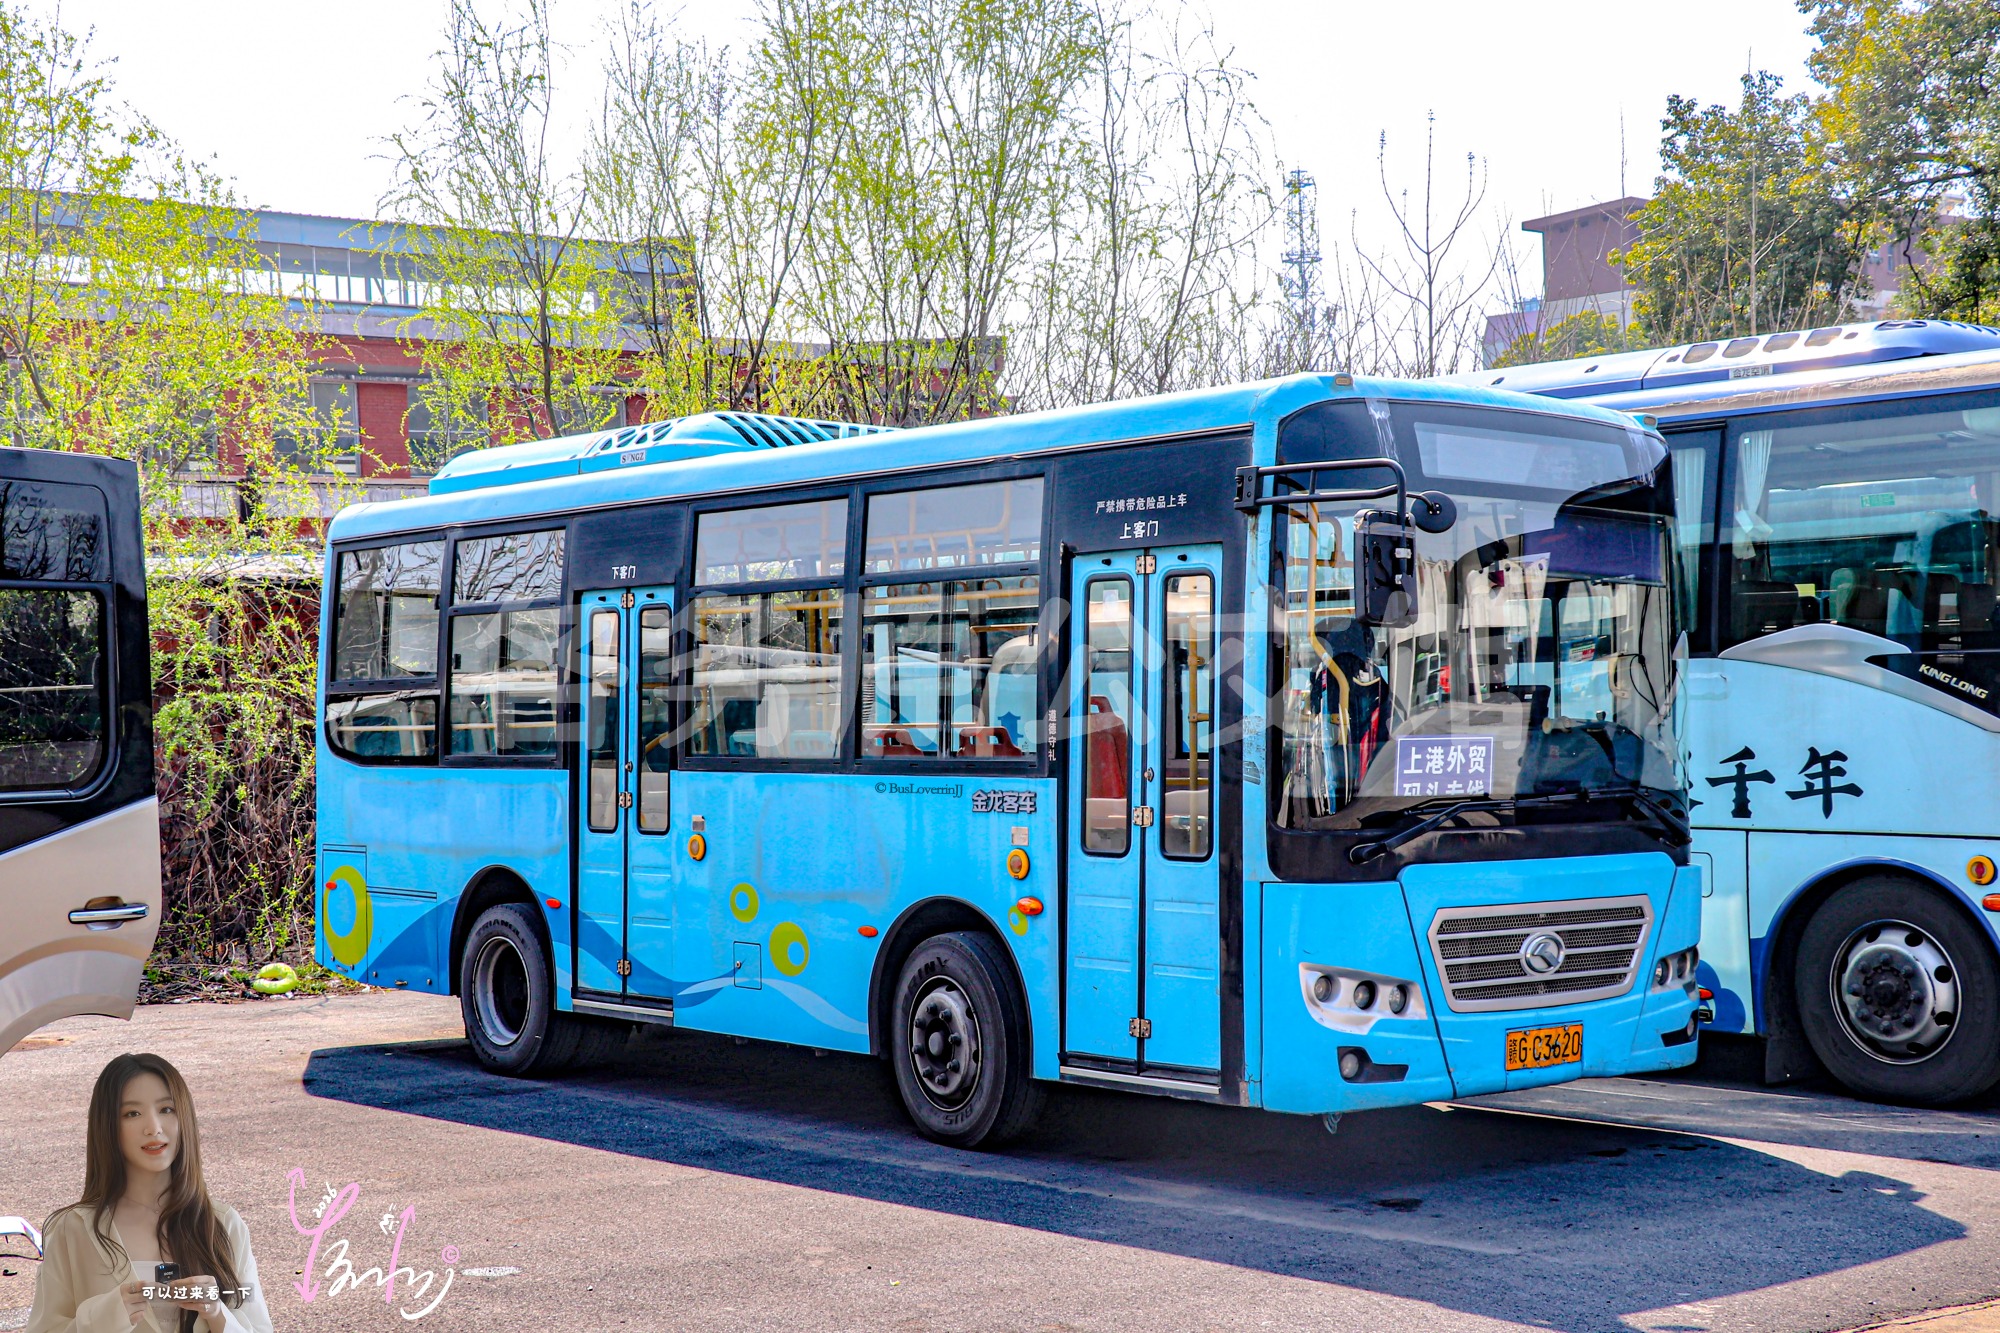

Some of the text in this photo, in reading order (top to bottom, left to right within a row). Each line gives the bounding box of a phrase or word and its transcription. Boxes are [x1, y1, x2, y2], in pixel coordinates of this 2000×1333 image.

[621, 452, 645, 464] SNGZ
[1095, 493, 1188, 514] 严禁携带危险品上车
[1119, 520, 1159, 540] 上客门
[611, 565, 636, 580] 下客门
[1918, 664, 1989, 699] KING LONG
[1403, 744, 1487, 775] 上港外贸
[1688, 745, 1864, 820] 千年
[971, 789, 1037, 815] 金龙客车
